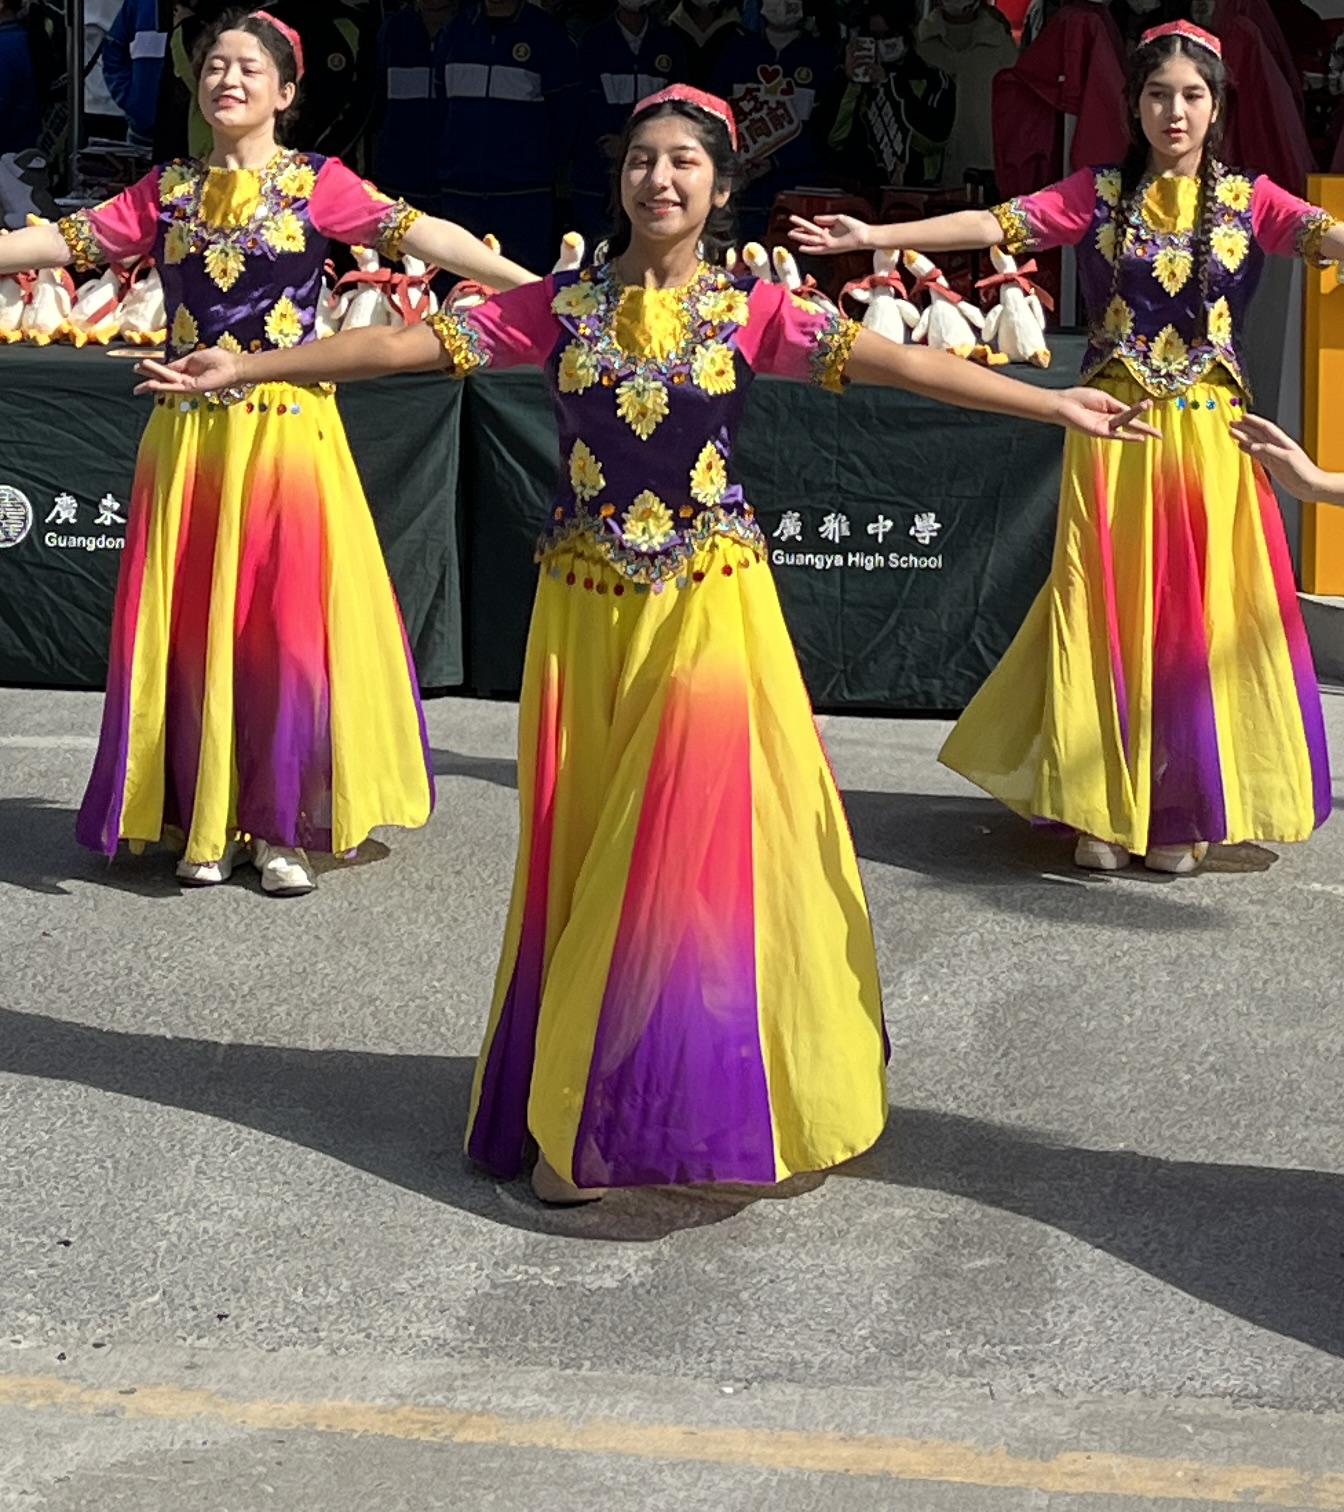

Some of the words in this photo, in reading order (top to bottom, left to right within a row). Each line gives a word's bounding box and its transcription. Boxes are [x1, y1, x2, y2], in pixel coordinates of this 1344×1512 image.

[44, 491, 128, 526] 廣東
[772, 510, 943, 545] 廣雅中學
[772, 549, 844, 570] Guangya
[847, 551, 885, 571] High
[888, 552, 943, 569] School
